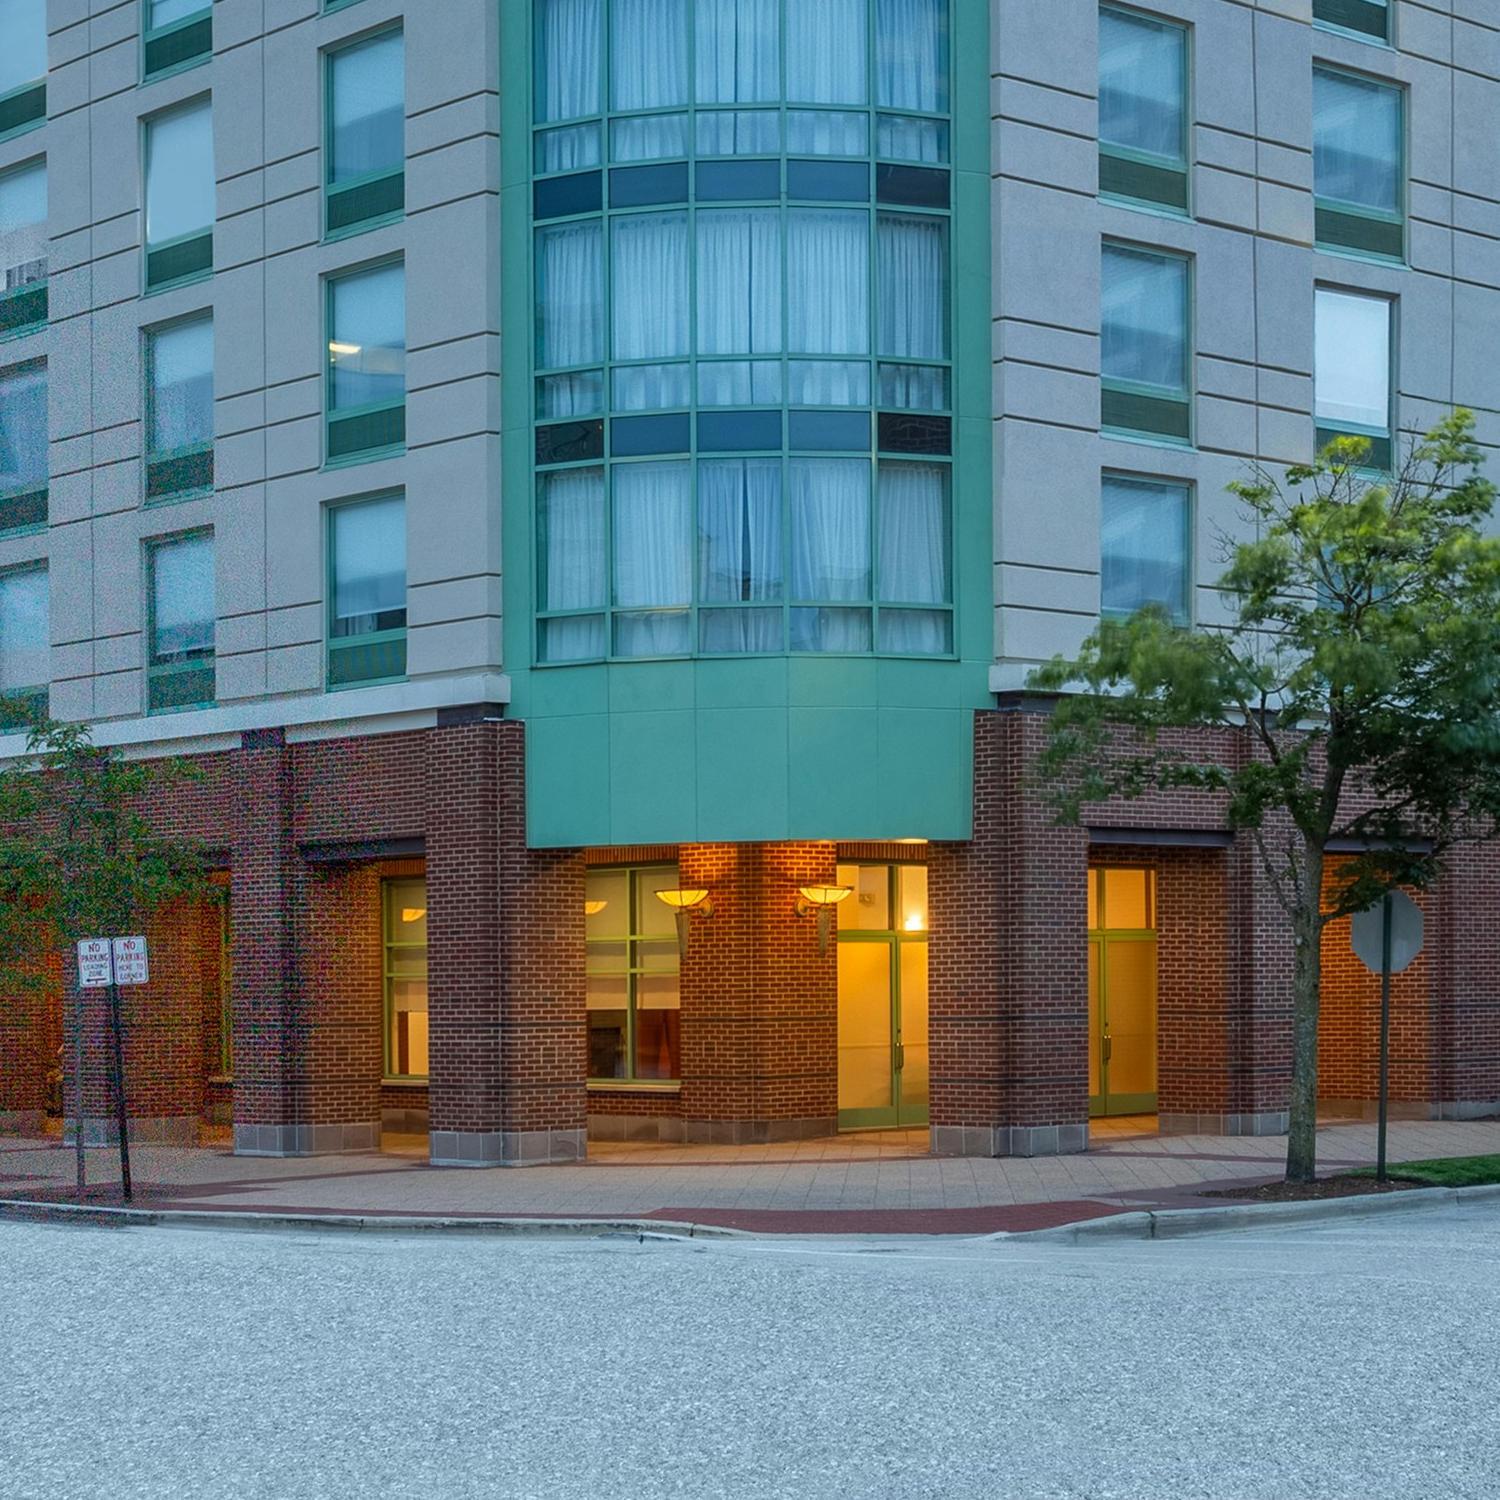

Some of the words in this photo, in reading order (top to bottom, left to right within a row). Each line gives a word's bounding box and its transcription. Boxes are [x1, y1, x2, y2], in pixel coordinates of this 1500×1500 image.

[88, 942, 101, 953] NO
[123, 940, 136, 951] NO
[81, 953, 109, 963] PARKING
[116, 952, 145, 962] PARKING
[83, 963, 108, 971] LOADING
